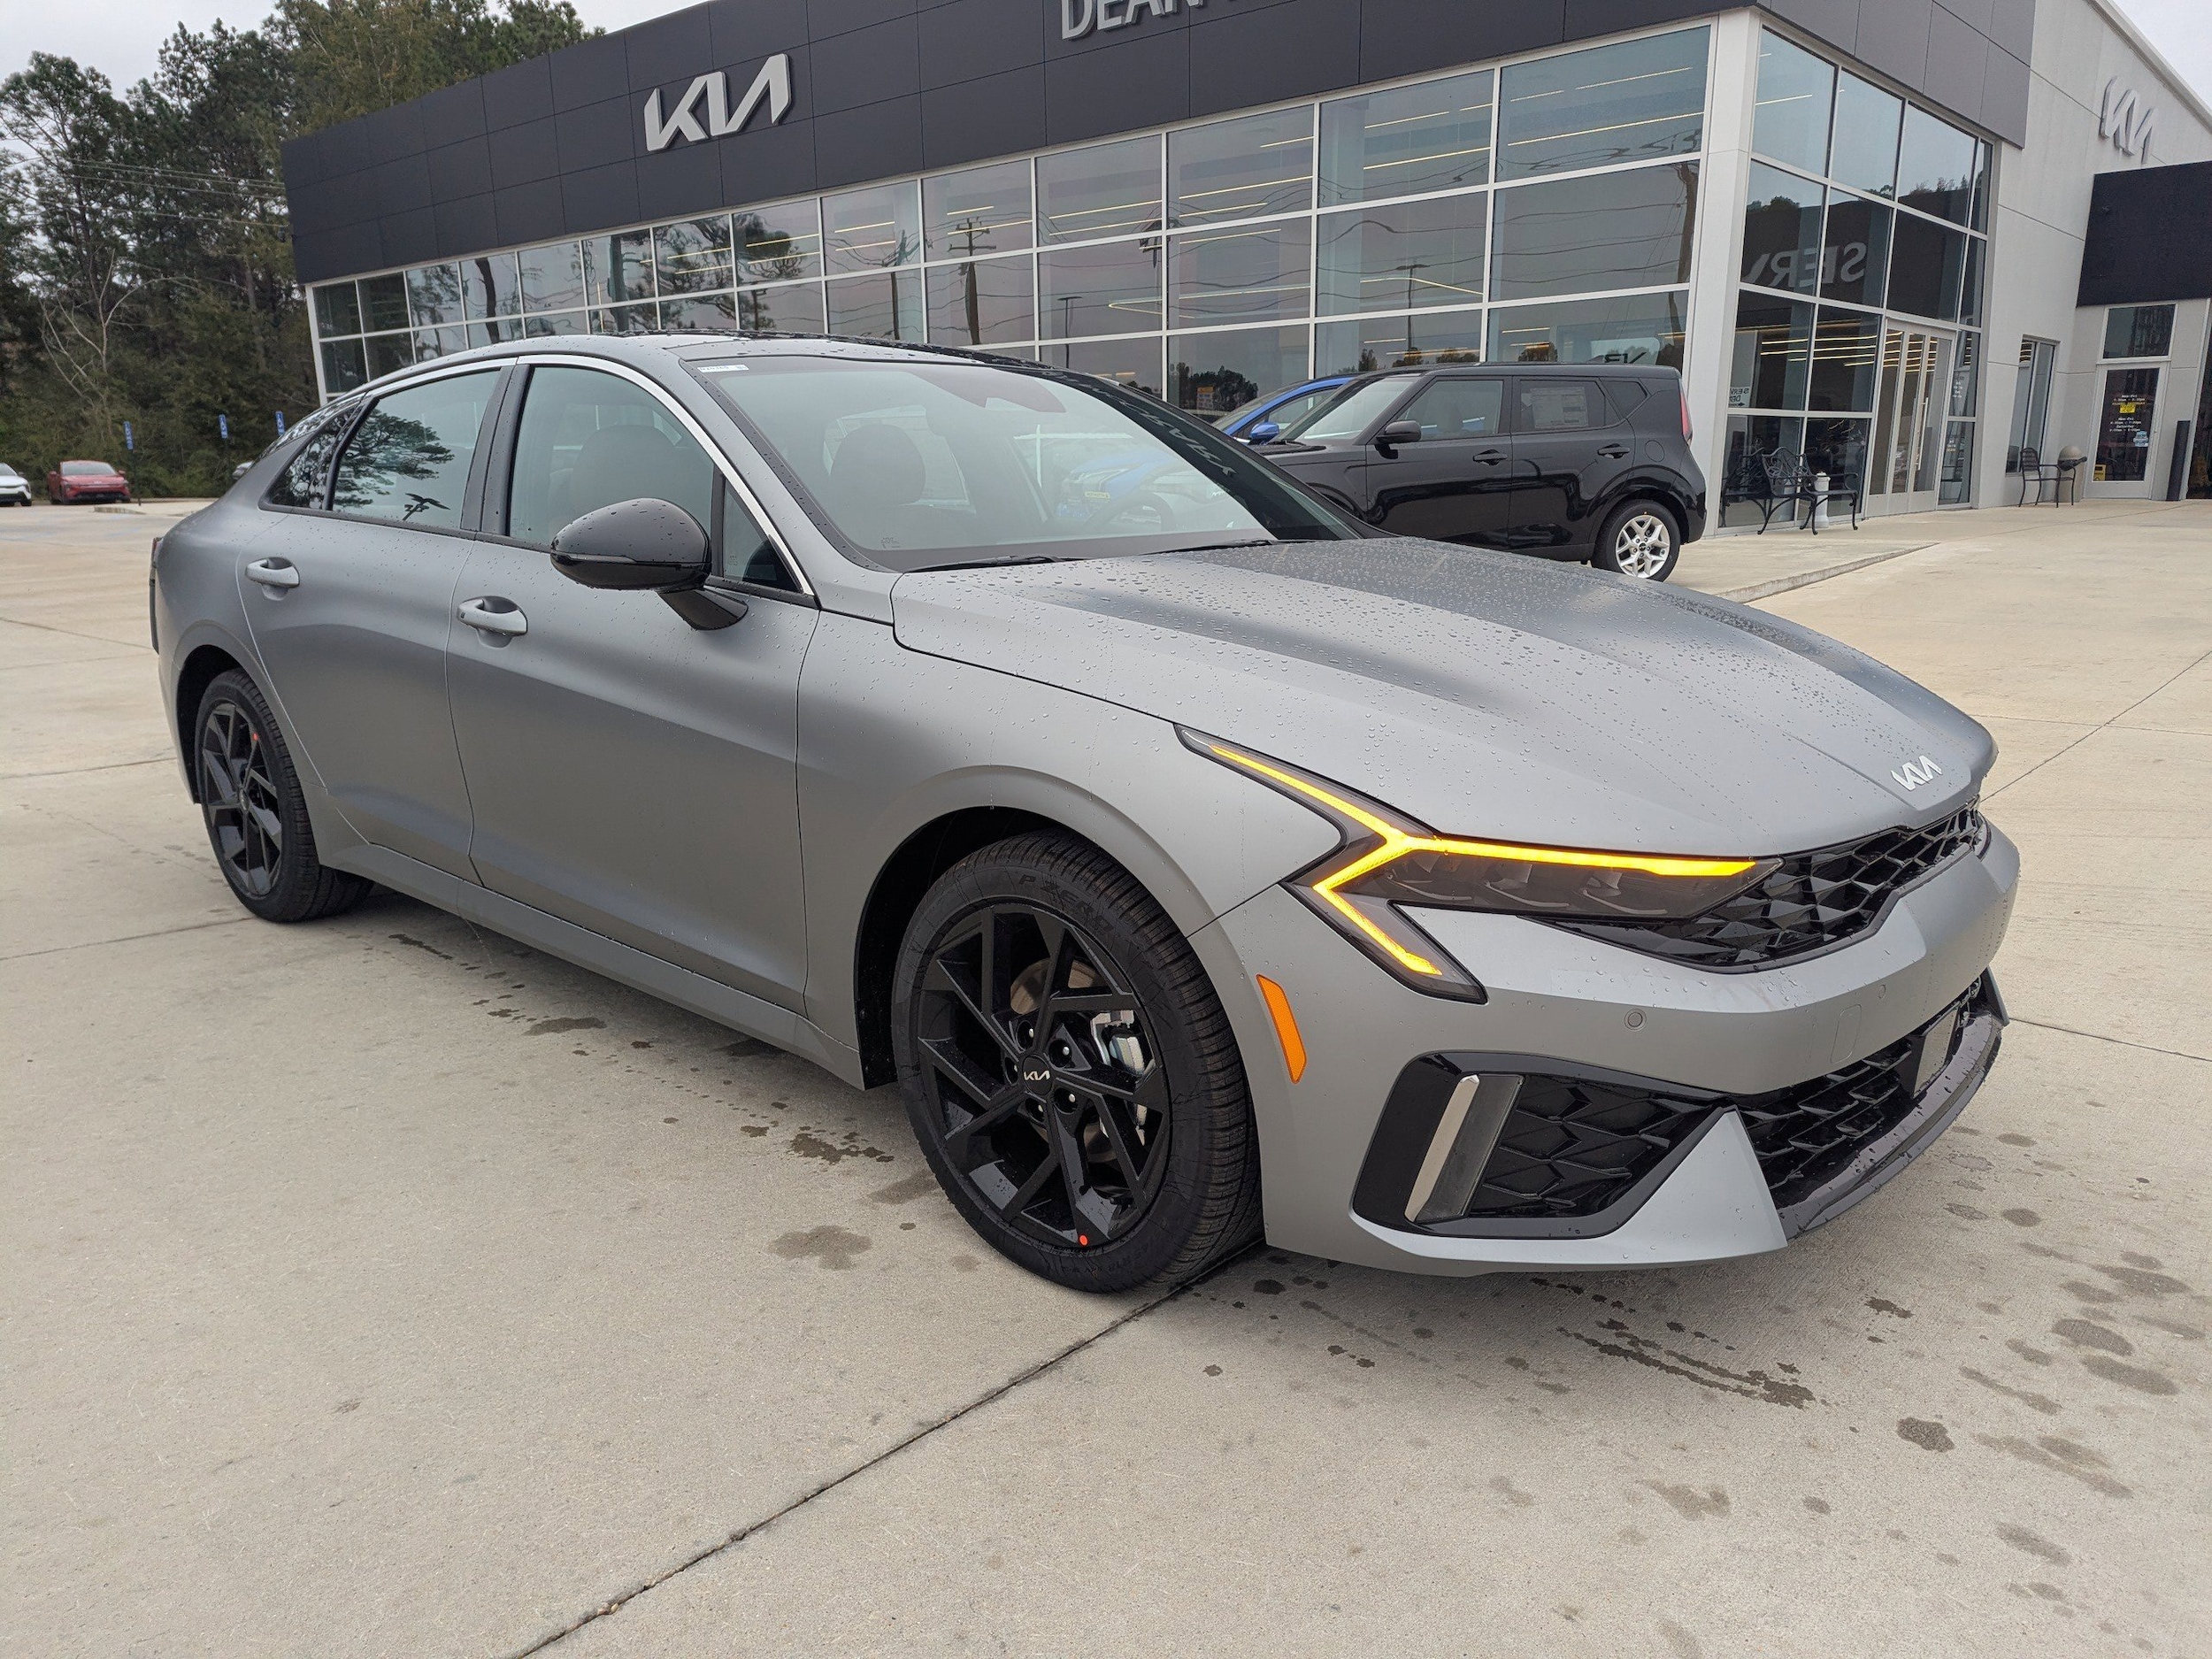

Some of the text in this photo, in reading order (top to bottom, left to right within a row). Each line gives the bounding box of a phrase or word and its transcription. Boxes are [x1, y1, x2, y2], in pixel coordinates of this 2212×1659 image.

[1061, 0, 1202, 40] DE
[644, 53, 792, 151] KIA
[2098, 75, 2160, 165] KIA
[1890, 755, 1943, 791] KIA
[1023, 1070, 1050, 1081] KIA
